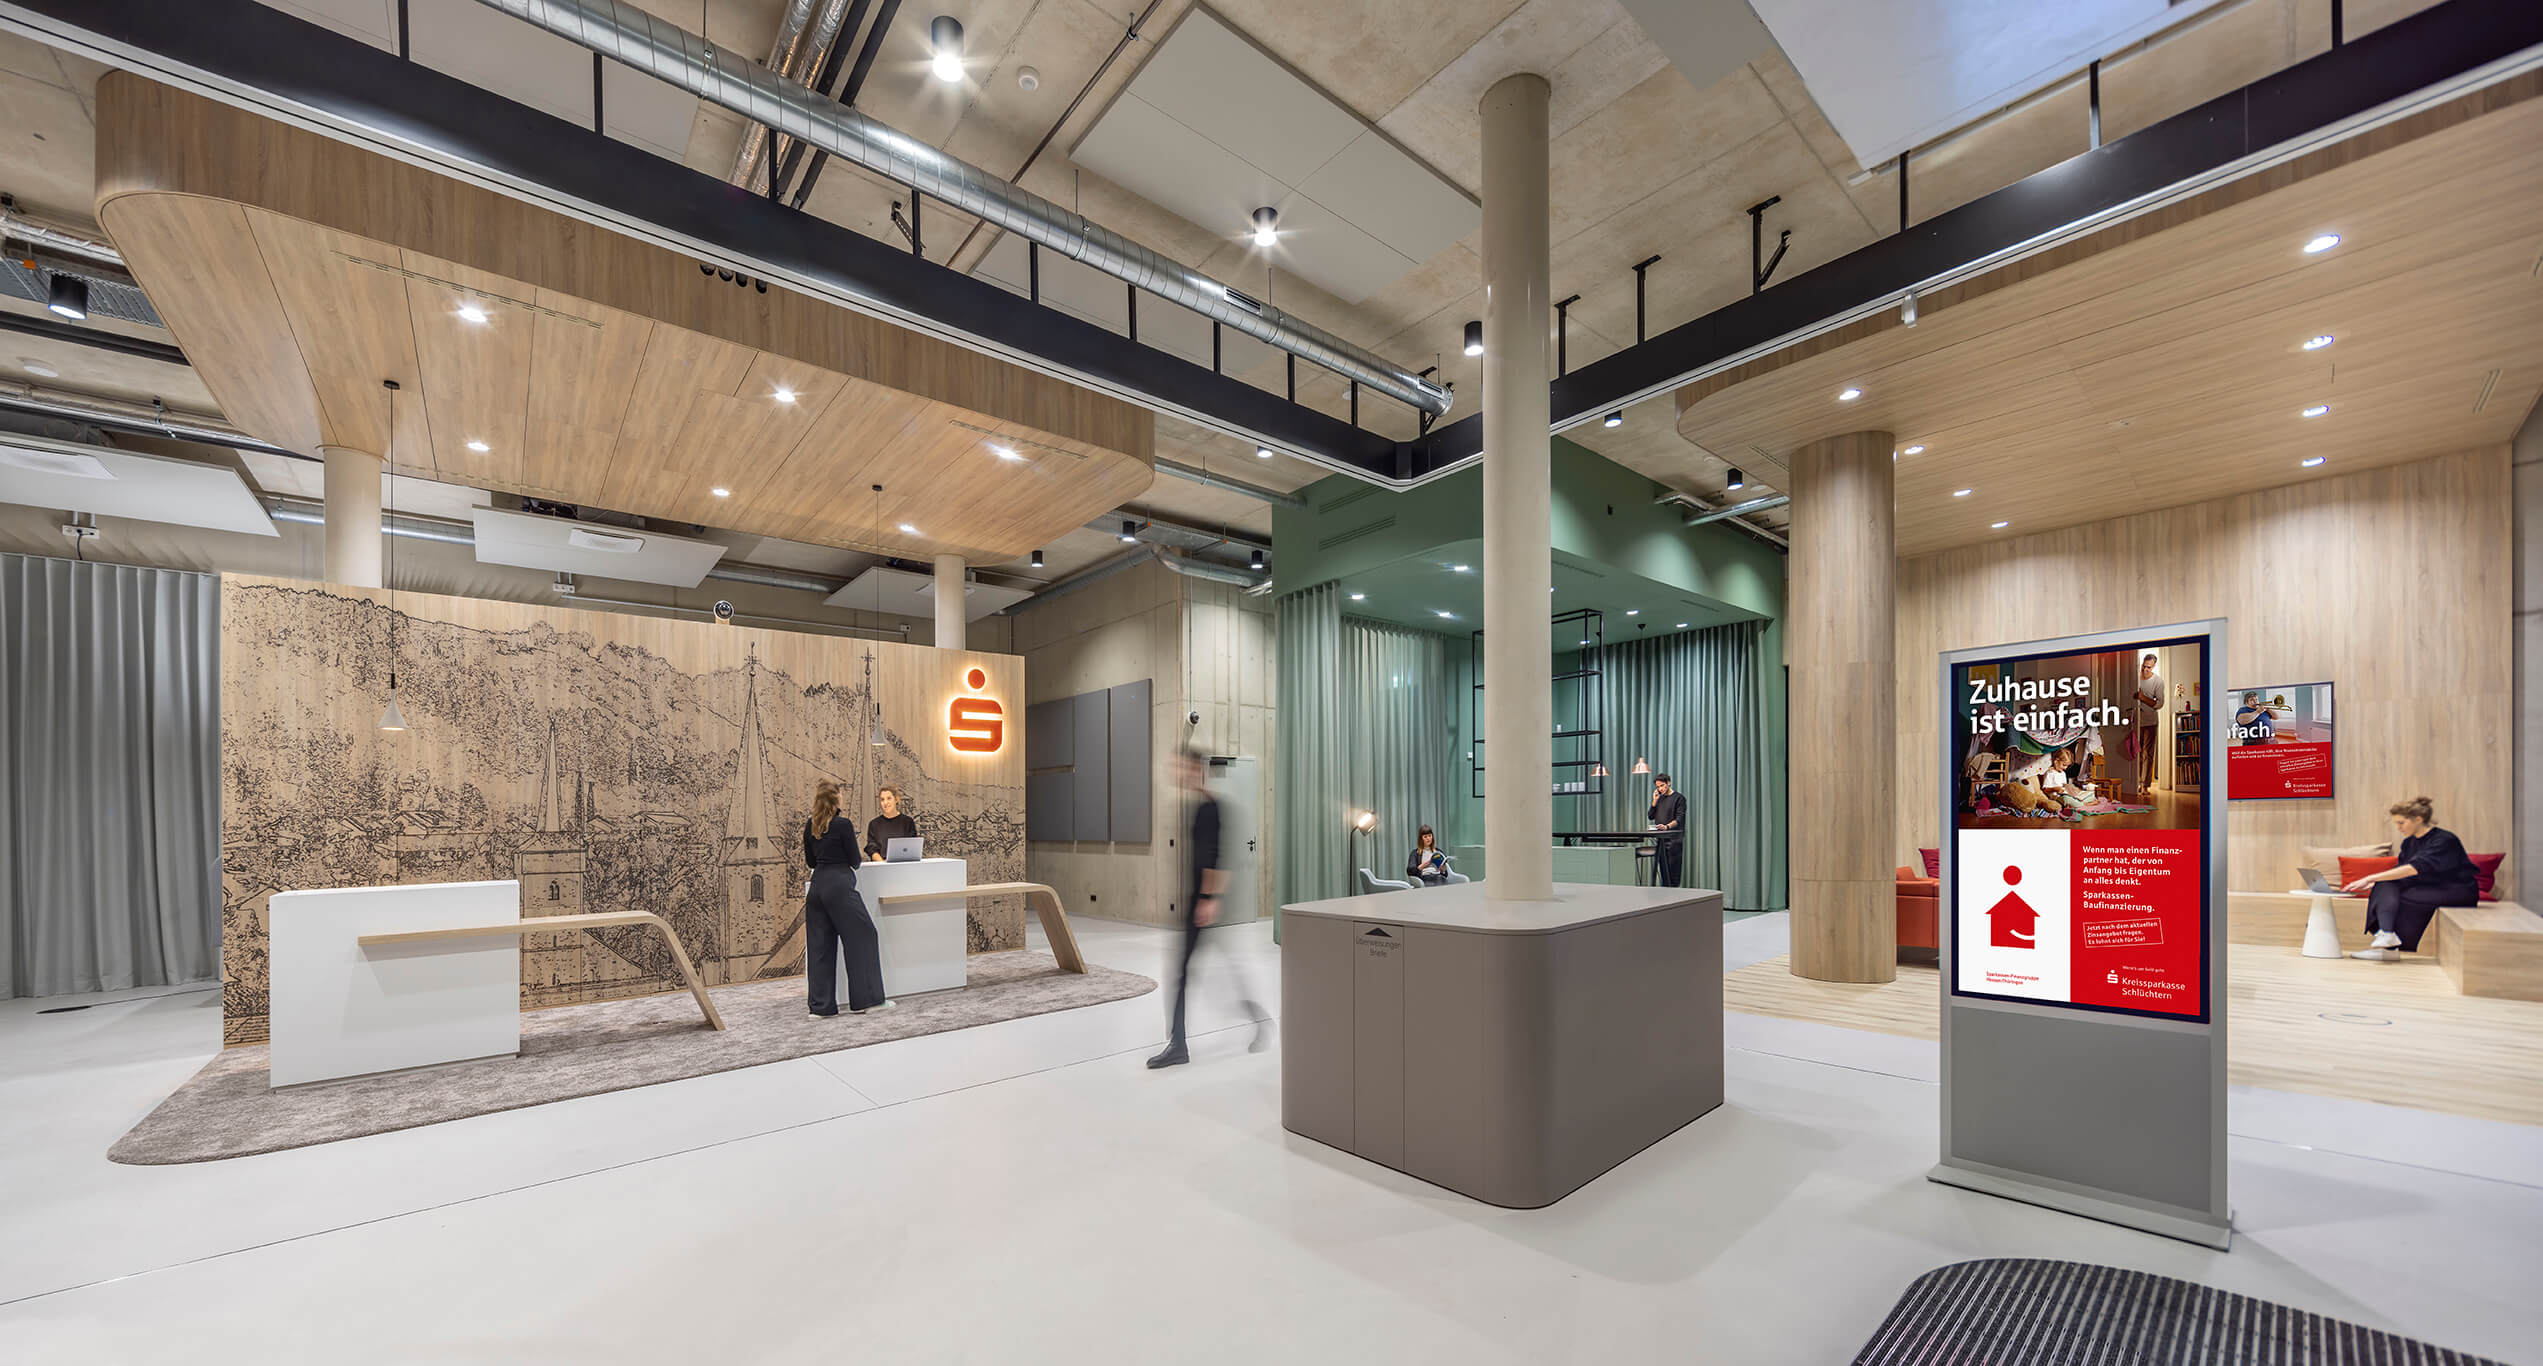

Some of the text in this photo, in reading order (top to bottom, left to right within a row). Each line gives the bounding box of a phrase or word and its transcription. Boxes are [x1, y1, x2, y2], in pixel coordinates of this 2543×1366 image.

[1969, 675, 2091, 704] Zuhause
[1969, 698, 2130, 734] ist einfach.
[2227, 721, 2275, 739] fach.
[2083, 846, 2105, 854] Wenn
[2126, 846, 2149, 854] einen
[2151, 846, 2183, 855] Finanz-
[2083, 857, 2113, 865] partner
[2115, 857, 2130, 865] hat,
[2083, 866, 2171, 876] Anfang bis Eigentum
[2094, 877, 2113, 885] alles
[2115, 877, 2141, 886] denkt.
[2083, 891, 2134, 900] Sparkassen-
[2083, 901, 2155, 913] Baufinanzierung.
[2130, 921, 2158, 929] aktuellen
[2088, 931, 2122, 939] Zinsangebot
[2122, 977, 2186, 991] Kreissparkasse
[2122, 988, 2172, 1000] Schlüchtern
